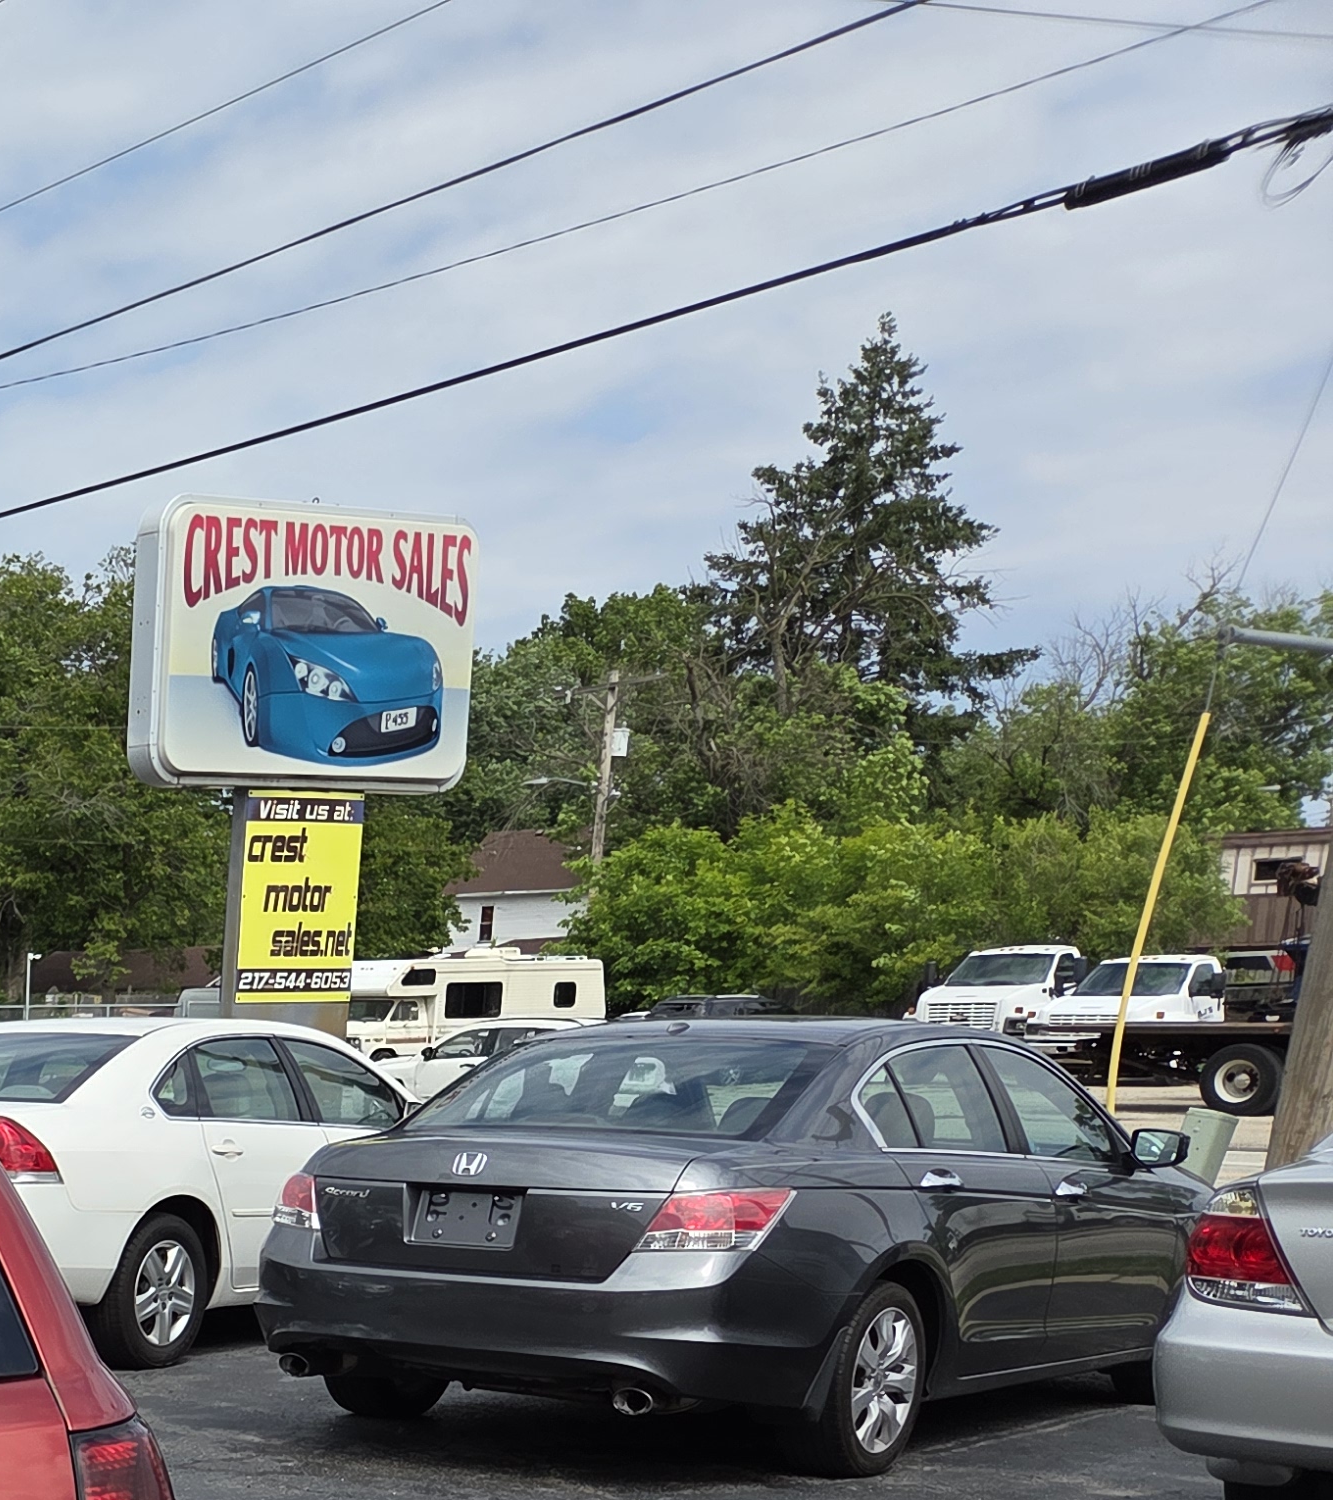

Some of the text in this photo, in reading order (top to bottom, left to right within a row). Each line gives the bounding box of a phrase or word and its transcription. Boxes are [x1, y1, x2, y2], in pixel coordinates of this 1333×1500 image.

[183, 513, 472, 627] CREST MOTOR SALES
[259, 800, 354, 821] Visit us at:
[247, 827, 308, 863] crest
[263, 876, 332, 913] motor
[269, 921, 352, 957] sales.net
[238, 971, 351, 990] 217-544-6053
[610, 1201, 644, 1212] V6
